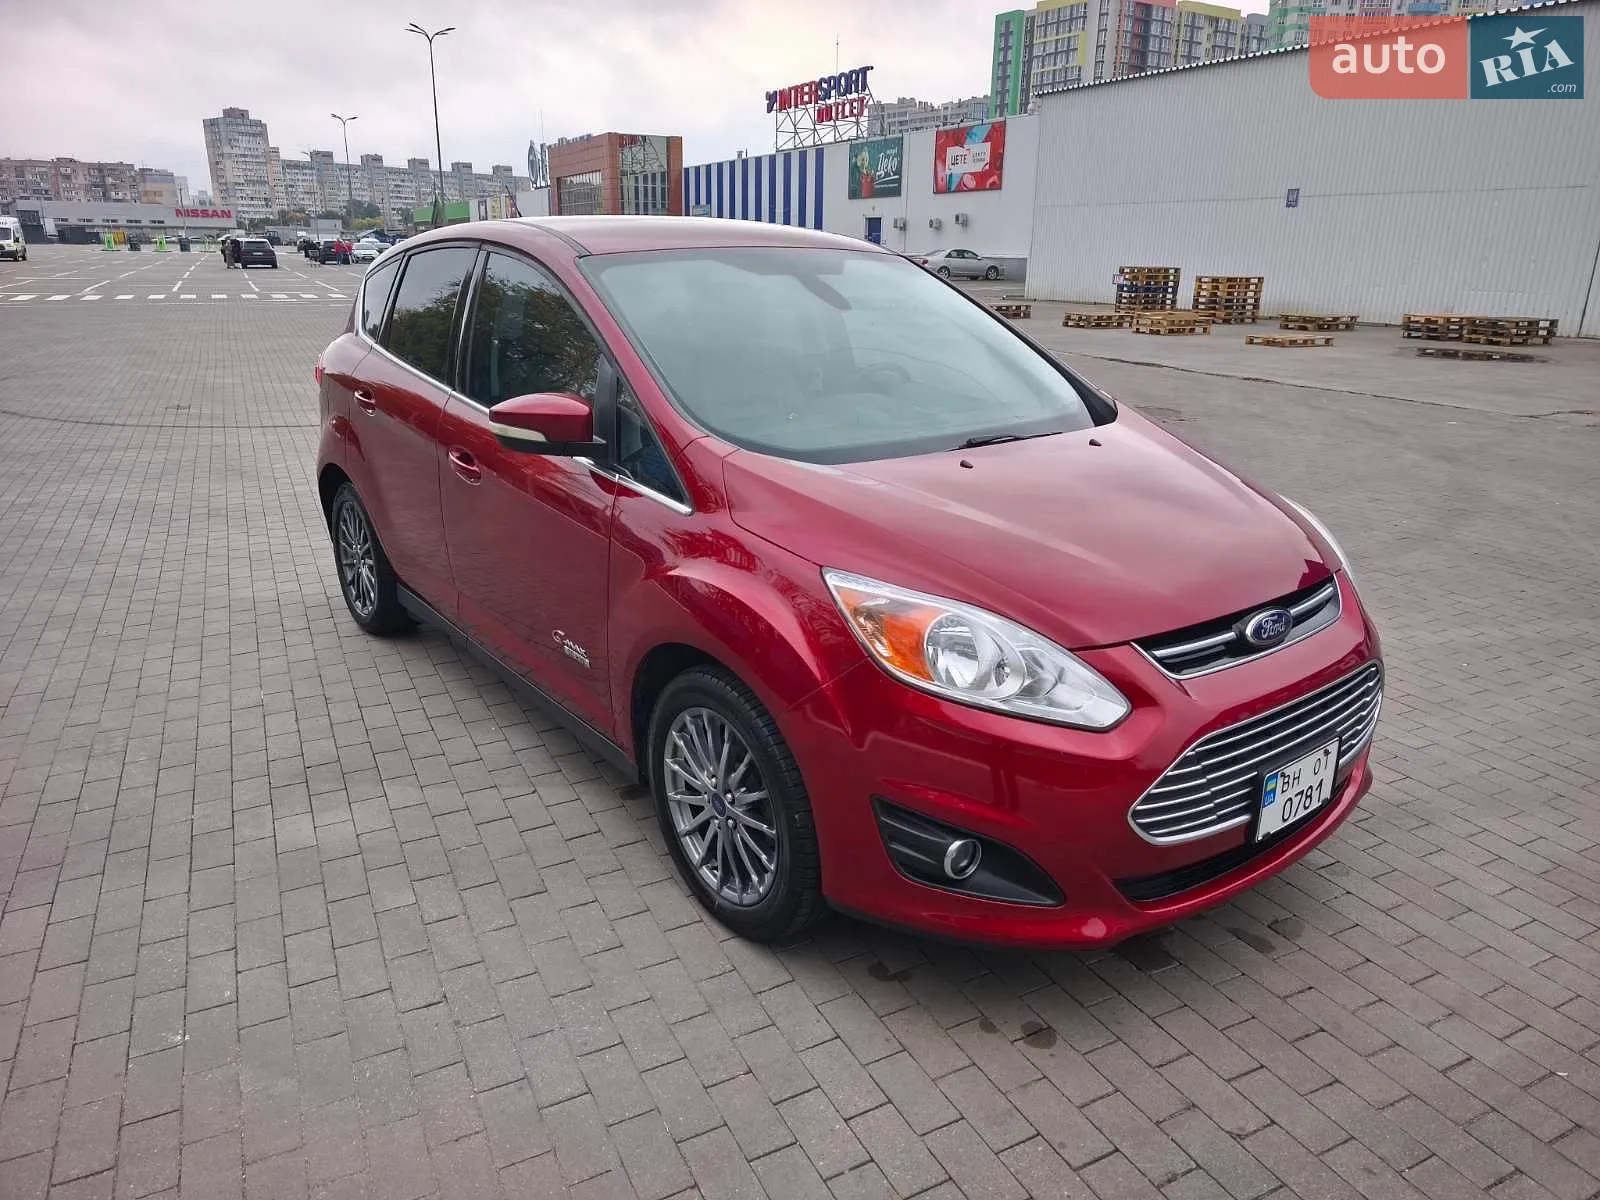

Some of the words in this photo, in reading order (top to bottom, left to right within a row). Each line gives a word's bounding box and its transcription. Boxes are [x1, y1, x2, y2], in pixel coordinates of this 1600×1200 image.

[778, 65, 873, 112] INTERSPORT
[175, 208, 232, 219] NISSAN
[1261, 616, 1287, 639] Ford
[1281, 767, 1302, 794] BH
[1264, 792, 1274, 805] UA
[1281, 778, 1324, 823] 0781
